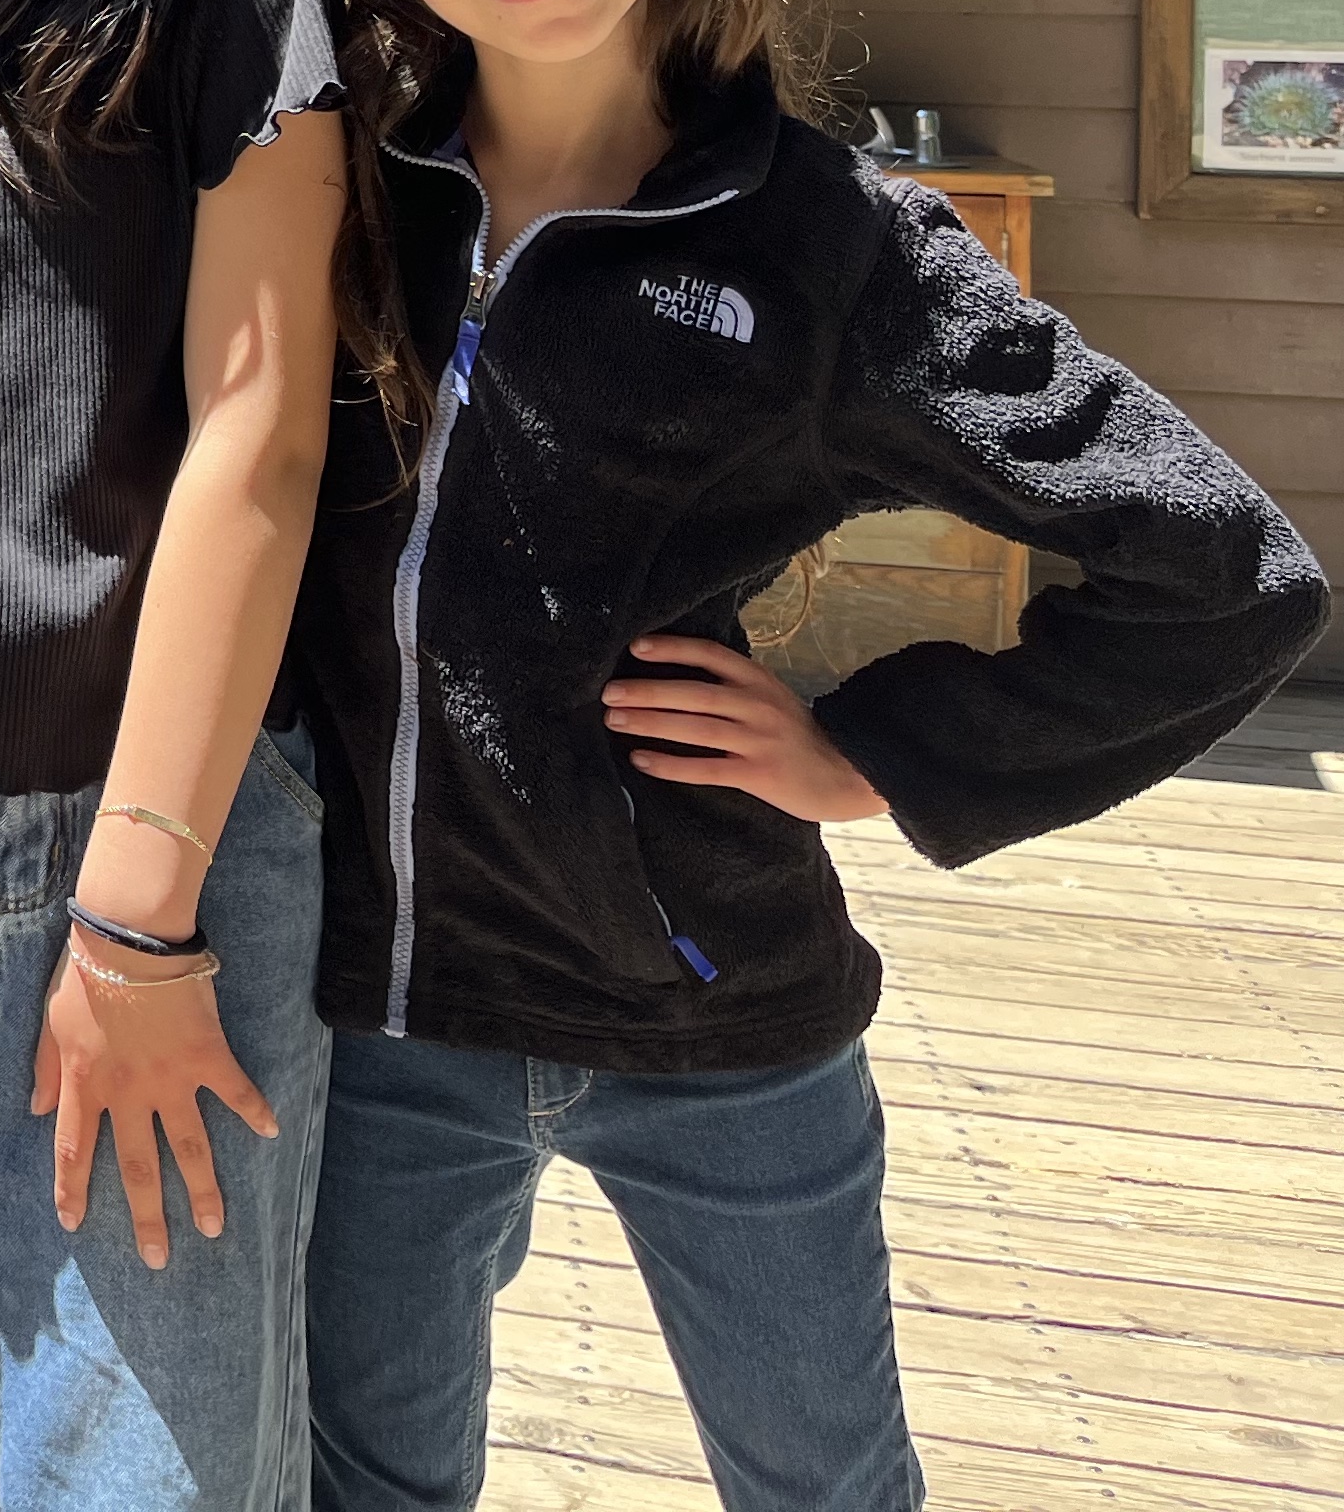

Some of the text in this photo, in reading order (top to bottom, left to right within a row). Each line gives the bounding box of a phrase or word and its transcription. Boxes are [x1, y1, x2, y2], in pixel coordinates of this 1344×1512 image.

[638, 278, 715, 316] NORTH
[677, 274, 720, 300] THE
[653, 301, 712, 331] FACE
